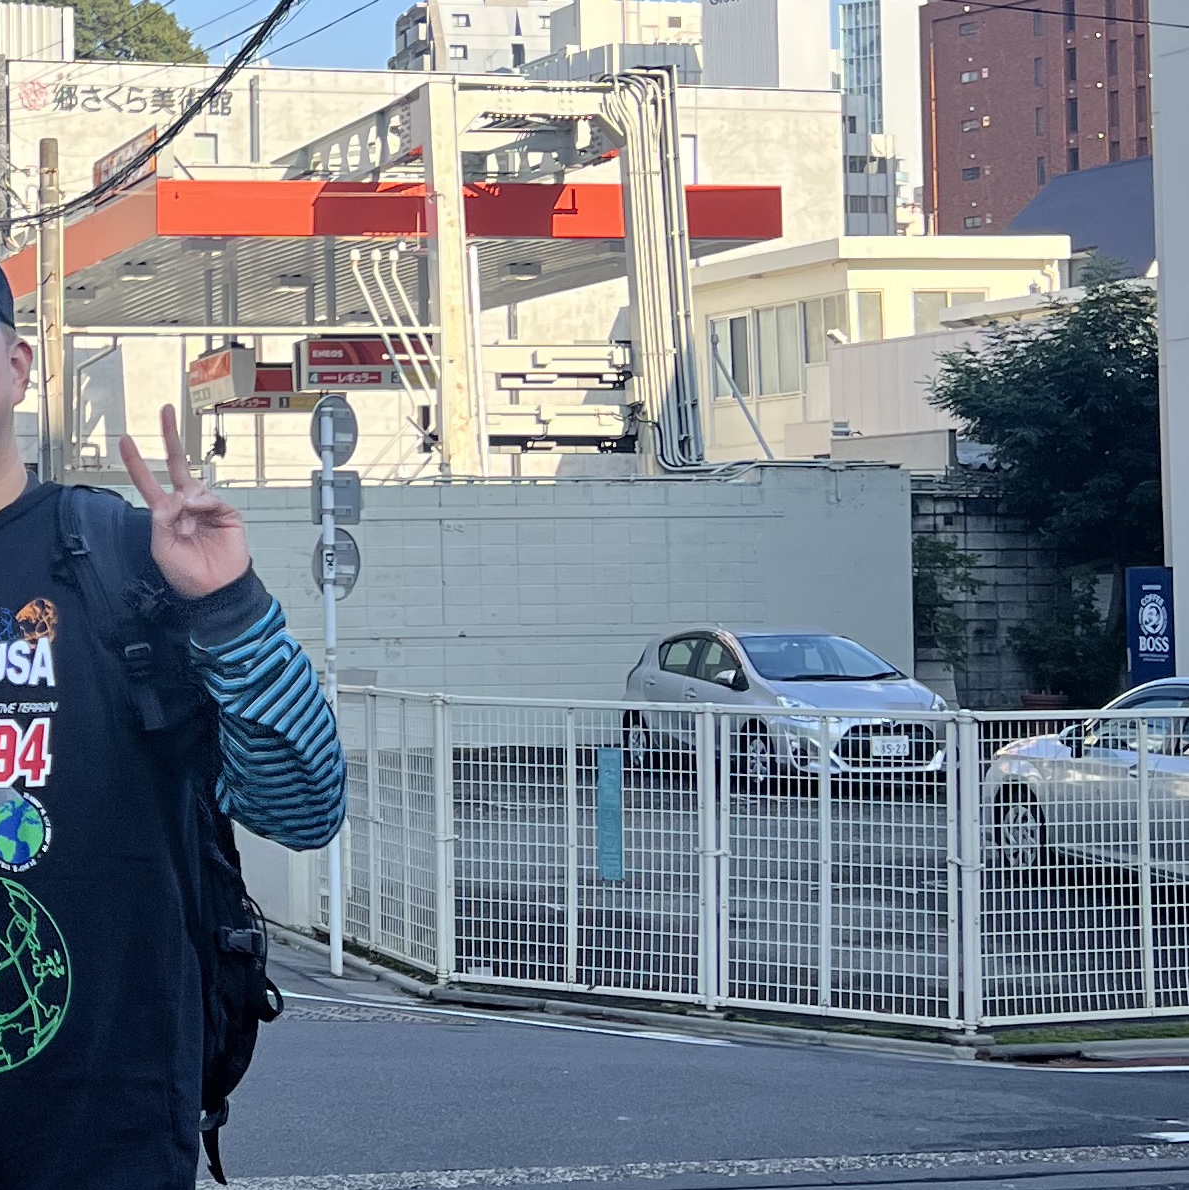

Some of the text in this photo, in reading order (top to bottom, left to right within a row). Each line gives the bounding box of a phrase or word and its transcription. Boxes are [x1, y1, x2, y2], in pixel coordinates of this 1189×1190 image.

[53, 84, 233, 116] 郷さくら美術館
[312, 349, 344, 358] ENEOS
[310, 372, 319, 384] 4
[1140, 593, 1165, 607] COFFEE
[1138, 635, 1170, 653] BOSS
